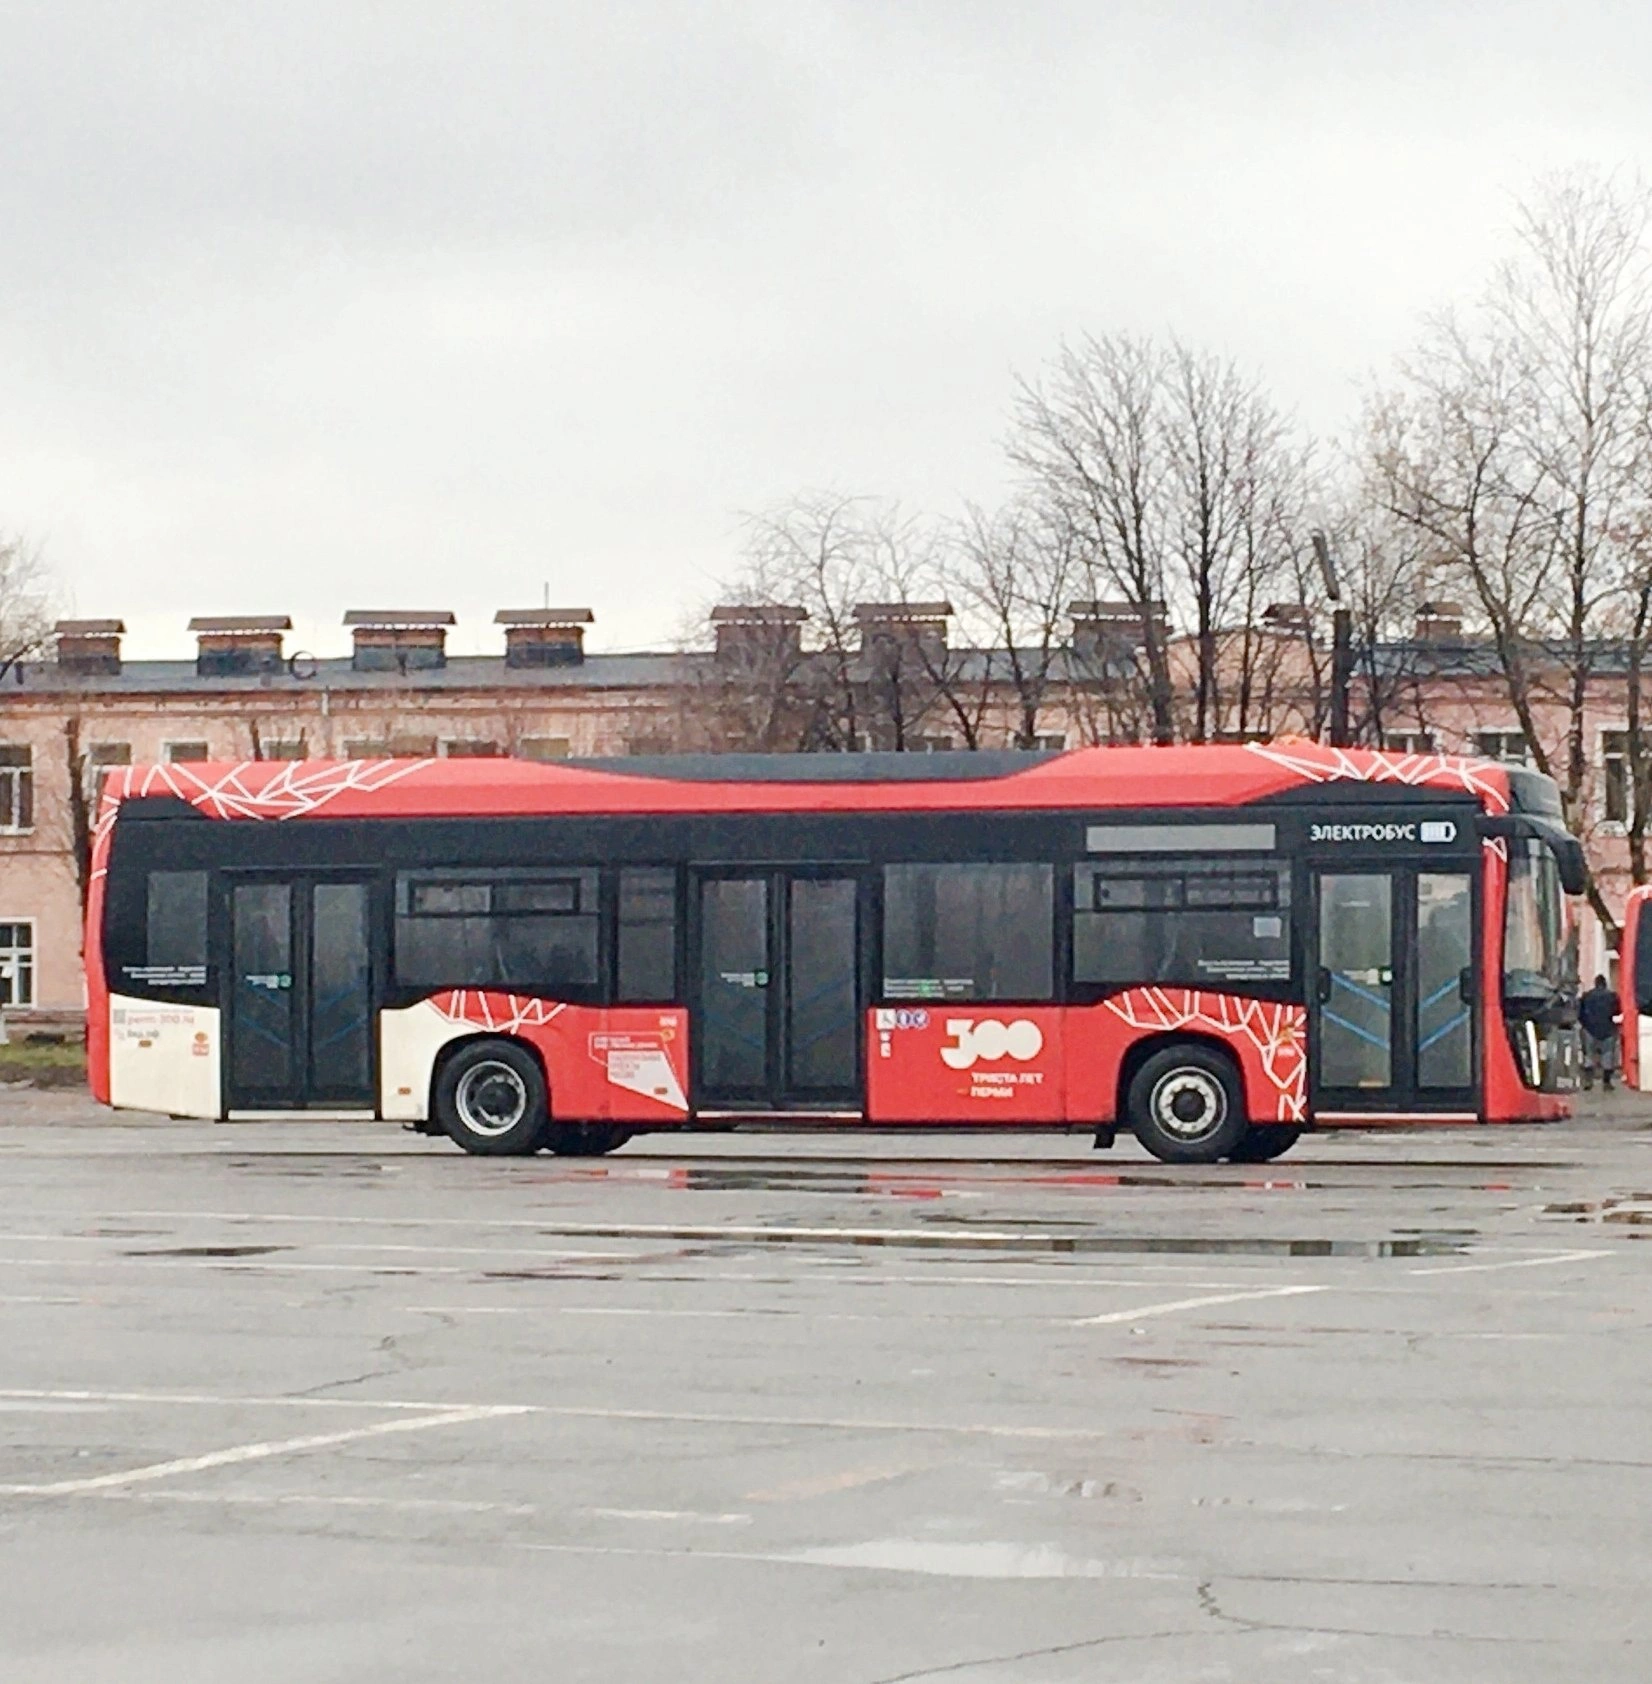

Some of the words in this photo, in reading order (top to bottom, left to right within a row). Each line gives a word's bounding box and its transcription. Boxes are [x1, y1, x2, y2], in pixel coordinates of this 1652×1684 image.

[1310, 823, 1416, 841] ЭЛЕКТРОБУС
[940, 1018, 1043, 1070] 300
[971, 1072, 1018, 1084] ТРИСТА
[1019, 1072, 1044, 1085] ЛЕТ
[970, 1086, 1014, 1098] ПЕРМИ
